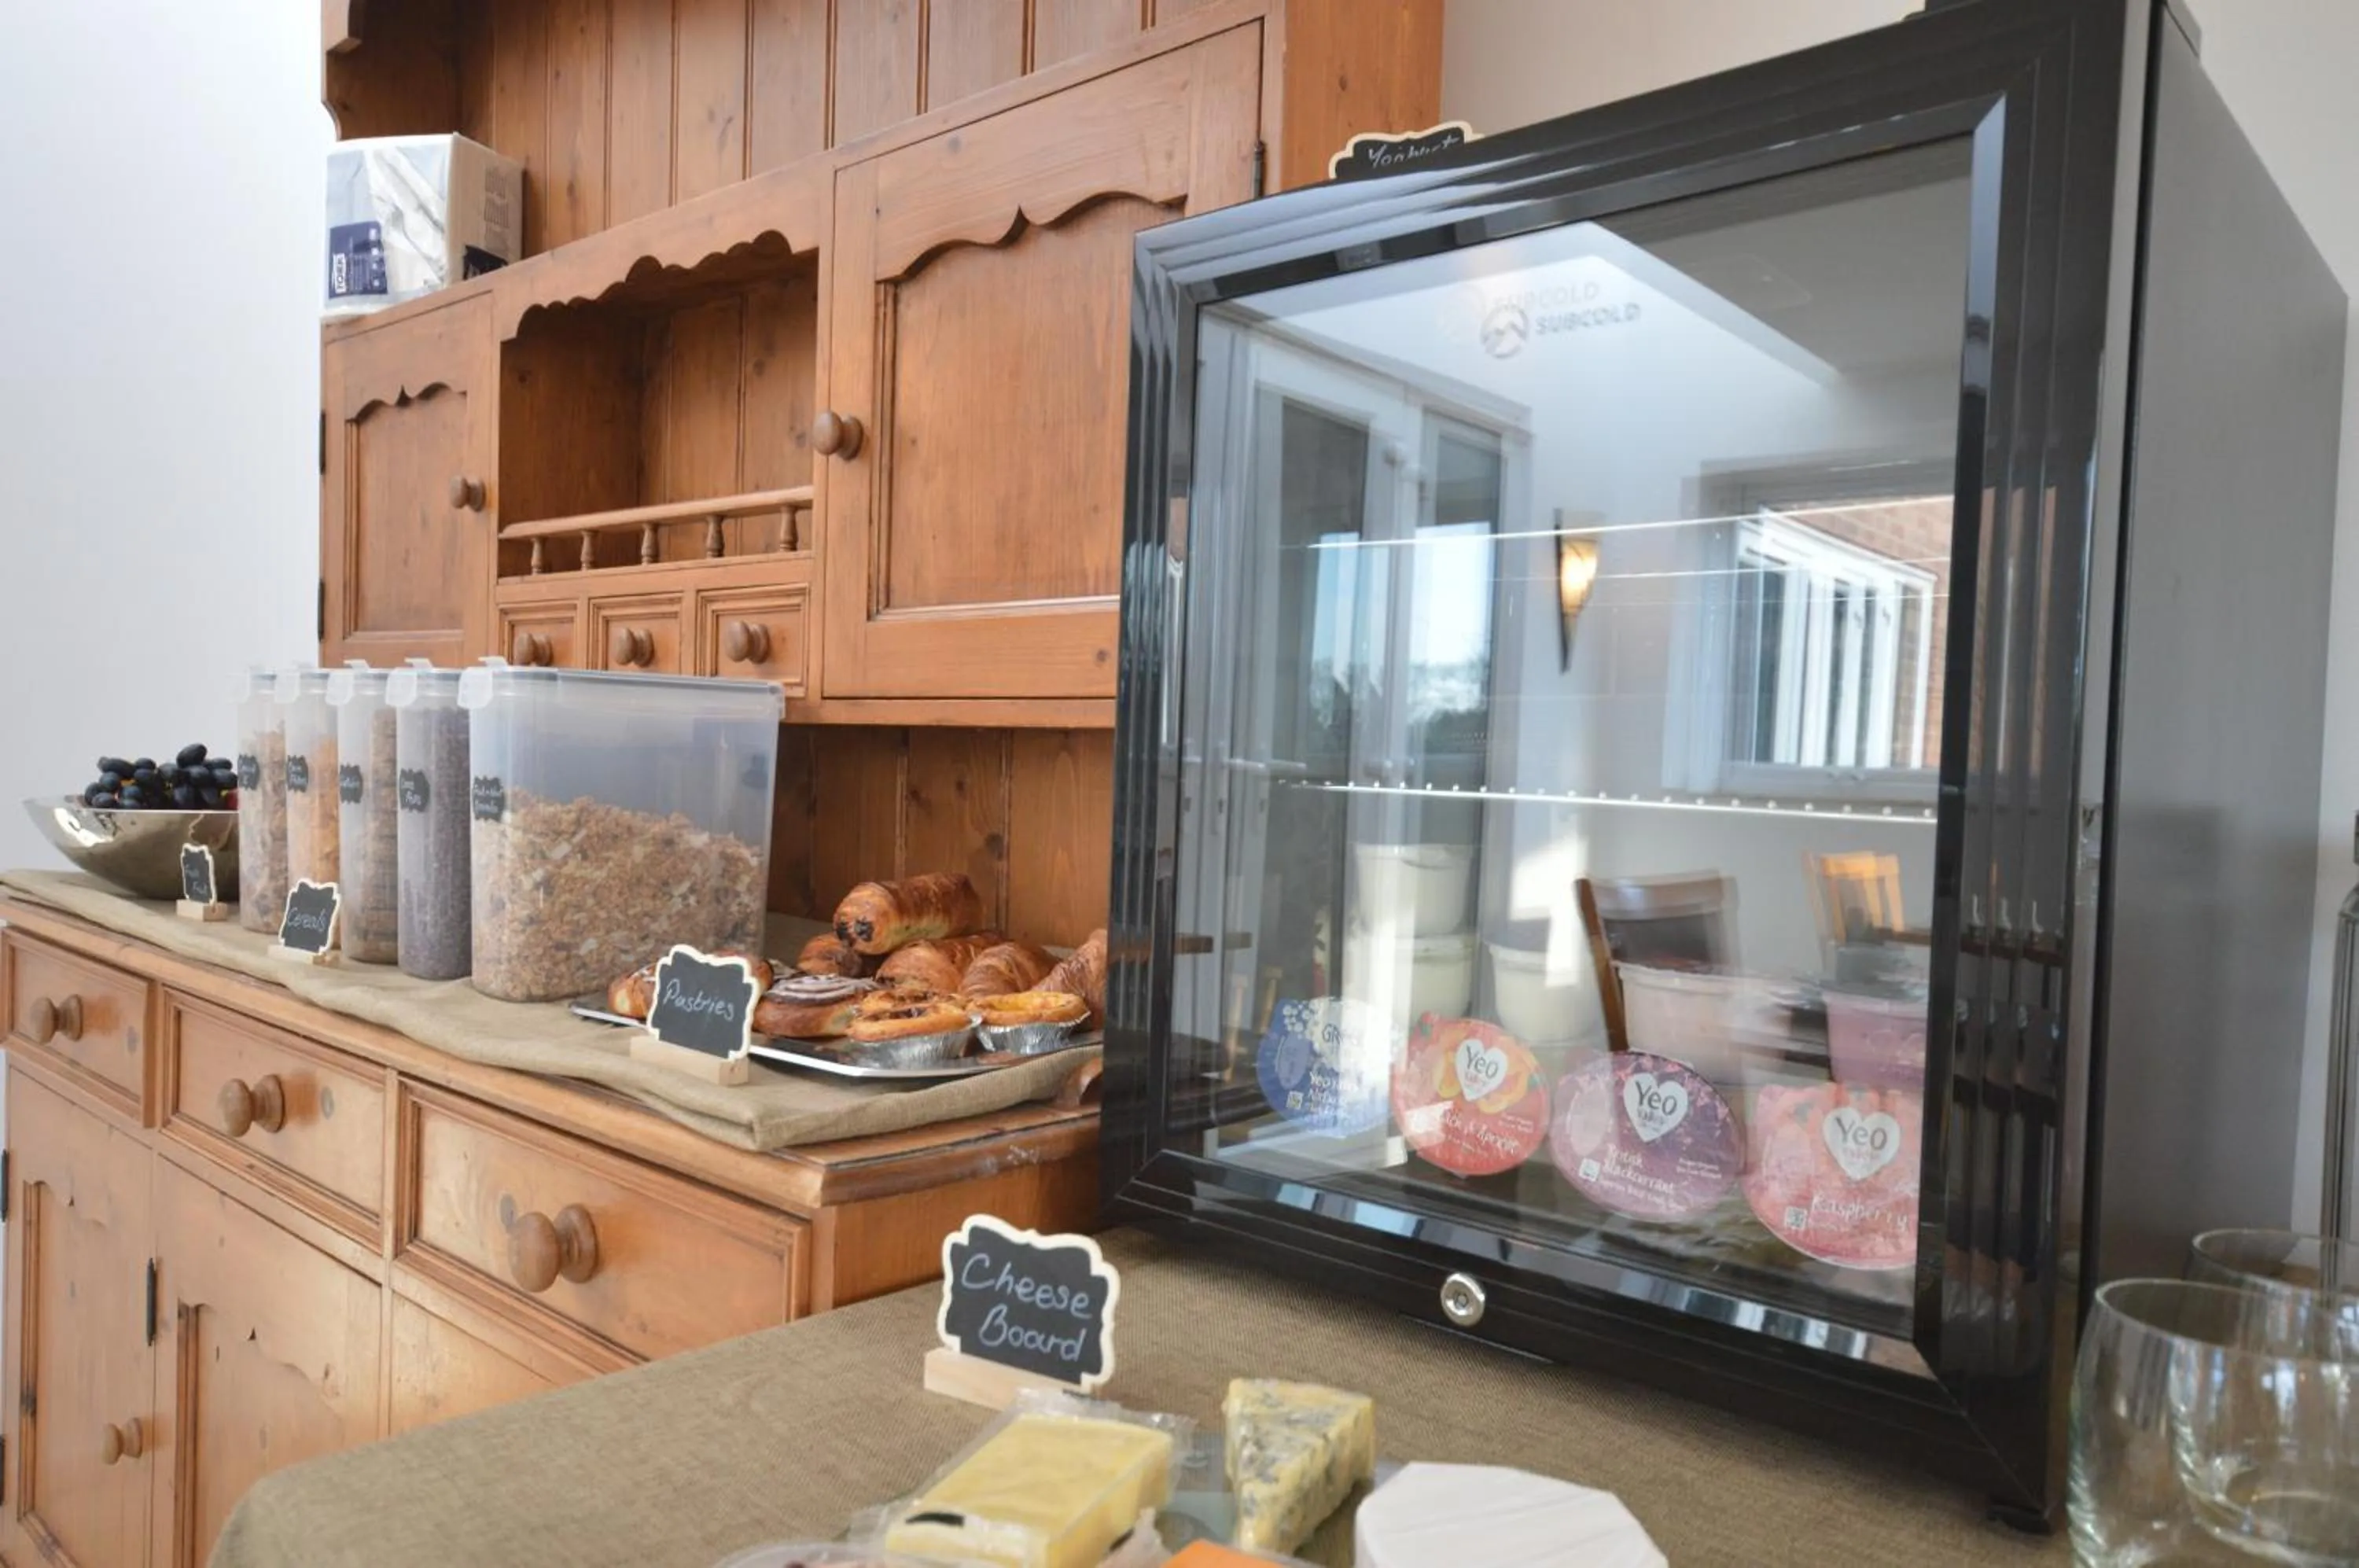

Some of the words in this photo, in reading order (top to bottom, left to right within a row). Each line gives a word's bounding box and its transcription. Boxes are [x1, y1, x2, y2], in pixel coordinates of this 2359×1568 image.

[1535, 302, 1642, 336] SUBCOLD
[663, 977, 734, 1021] Pastries
[961, 1253, 1092, 1320] Cheese
[978, 1304, 1087, 1362] Board
